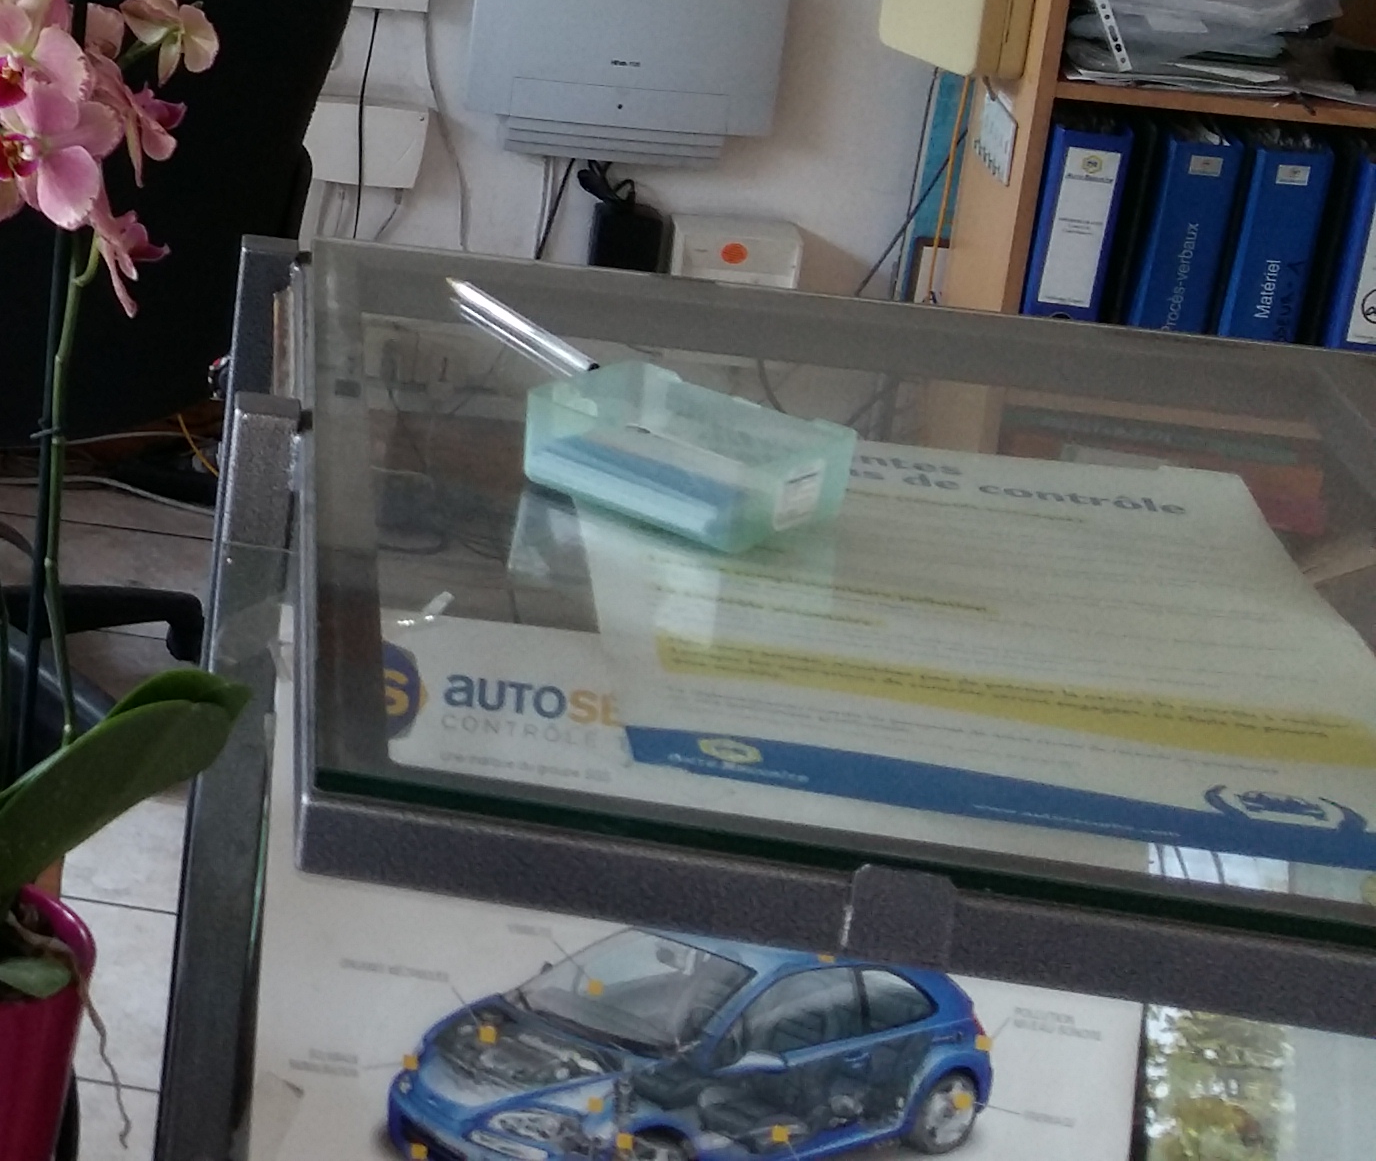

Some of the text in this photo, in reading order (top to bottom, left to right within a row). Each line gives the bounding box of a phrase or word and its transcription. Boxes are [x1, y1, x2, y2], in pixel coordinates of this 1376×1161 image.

[1254, 259, 1282, 319] Matériel
[852, 453, 963, 476] ntes
[903, 473, 960, 490] de
[978, 484, 1187, 516] contrôle
